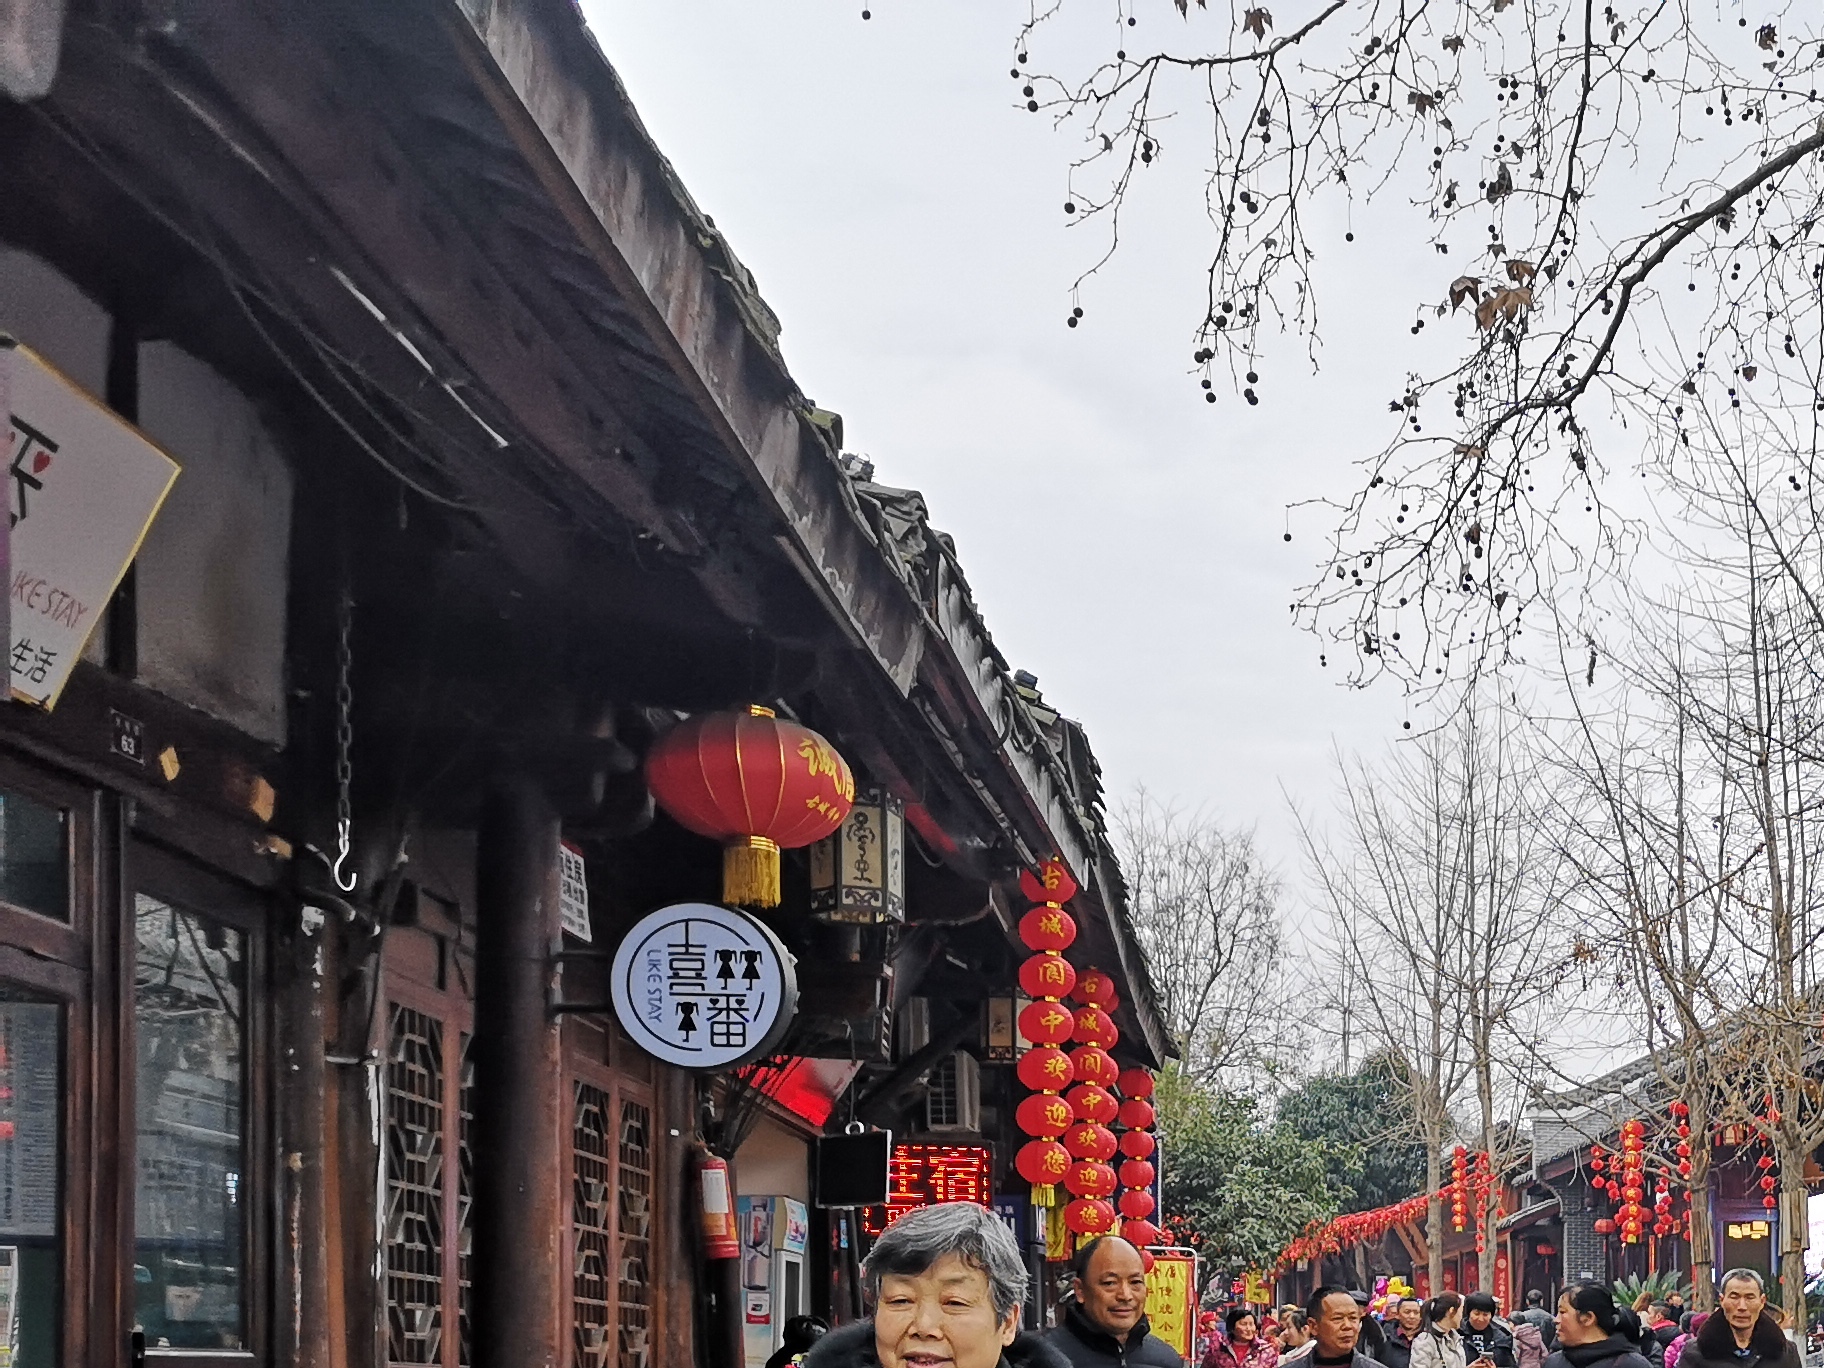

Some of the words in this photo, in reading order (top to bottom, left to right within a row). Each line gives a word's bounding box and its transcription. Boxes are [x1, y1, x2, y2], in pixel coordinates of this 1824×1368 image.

[12, 569, 47, 609] IKE
[42, 587, 88, 630] STAY
[12, 638, 57, 684] 生活
[121, 734, 135, 755] 63
[646, 948, 663, 984] LIKE
[647, 989, 663, 1024] STAY
[1039, 866, 1068, 1175] 古城阆中欢迎您
[1078, 977, 1102, 1226] 古城阆中欢迎您
